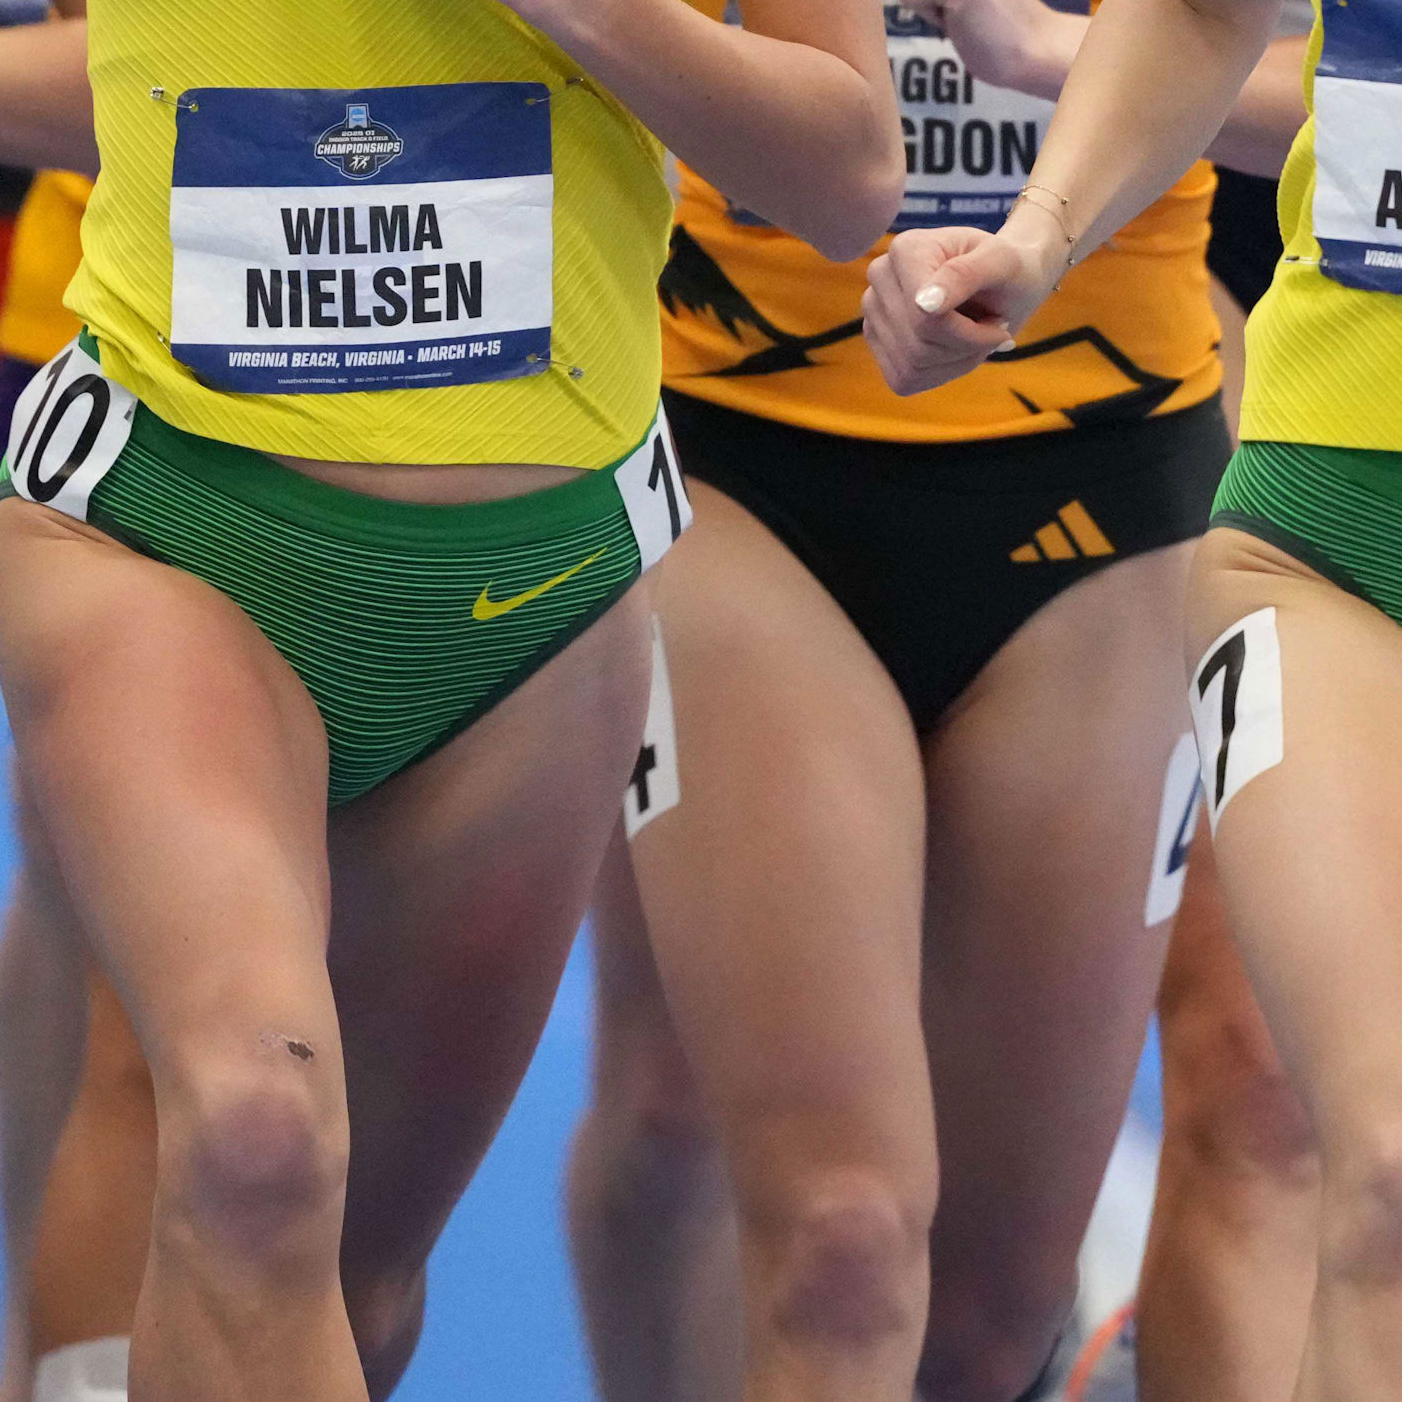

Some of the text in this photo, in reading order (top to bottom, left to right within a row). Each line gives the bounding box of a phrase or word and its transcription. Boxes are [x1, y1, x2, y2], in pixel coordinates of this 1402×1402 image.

[890, 57, 973, 104] GGI
[317, 141, 400, 155] CHAMPIONSHIPS
[280, 203, 443, 255] WILMA
[246, 261, 483, 328] NIELSEN
[228, 339, 502, 368] VIRGINIA BEACH, VIRGINIA MARCH 14-15
[13, 348, 112, 503] 10
